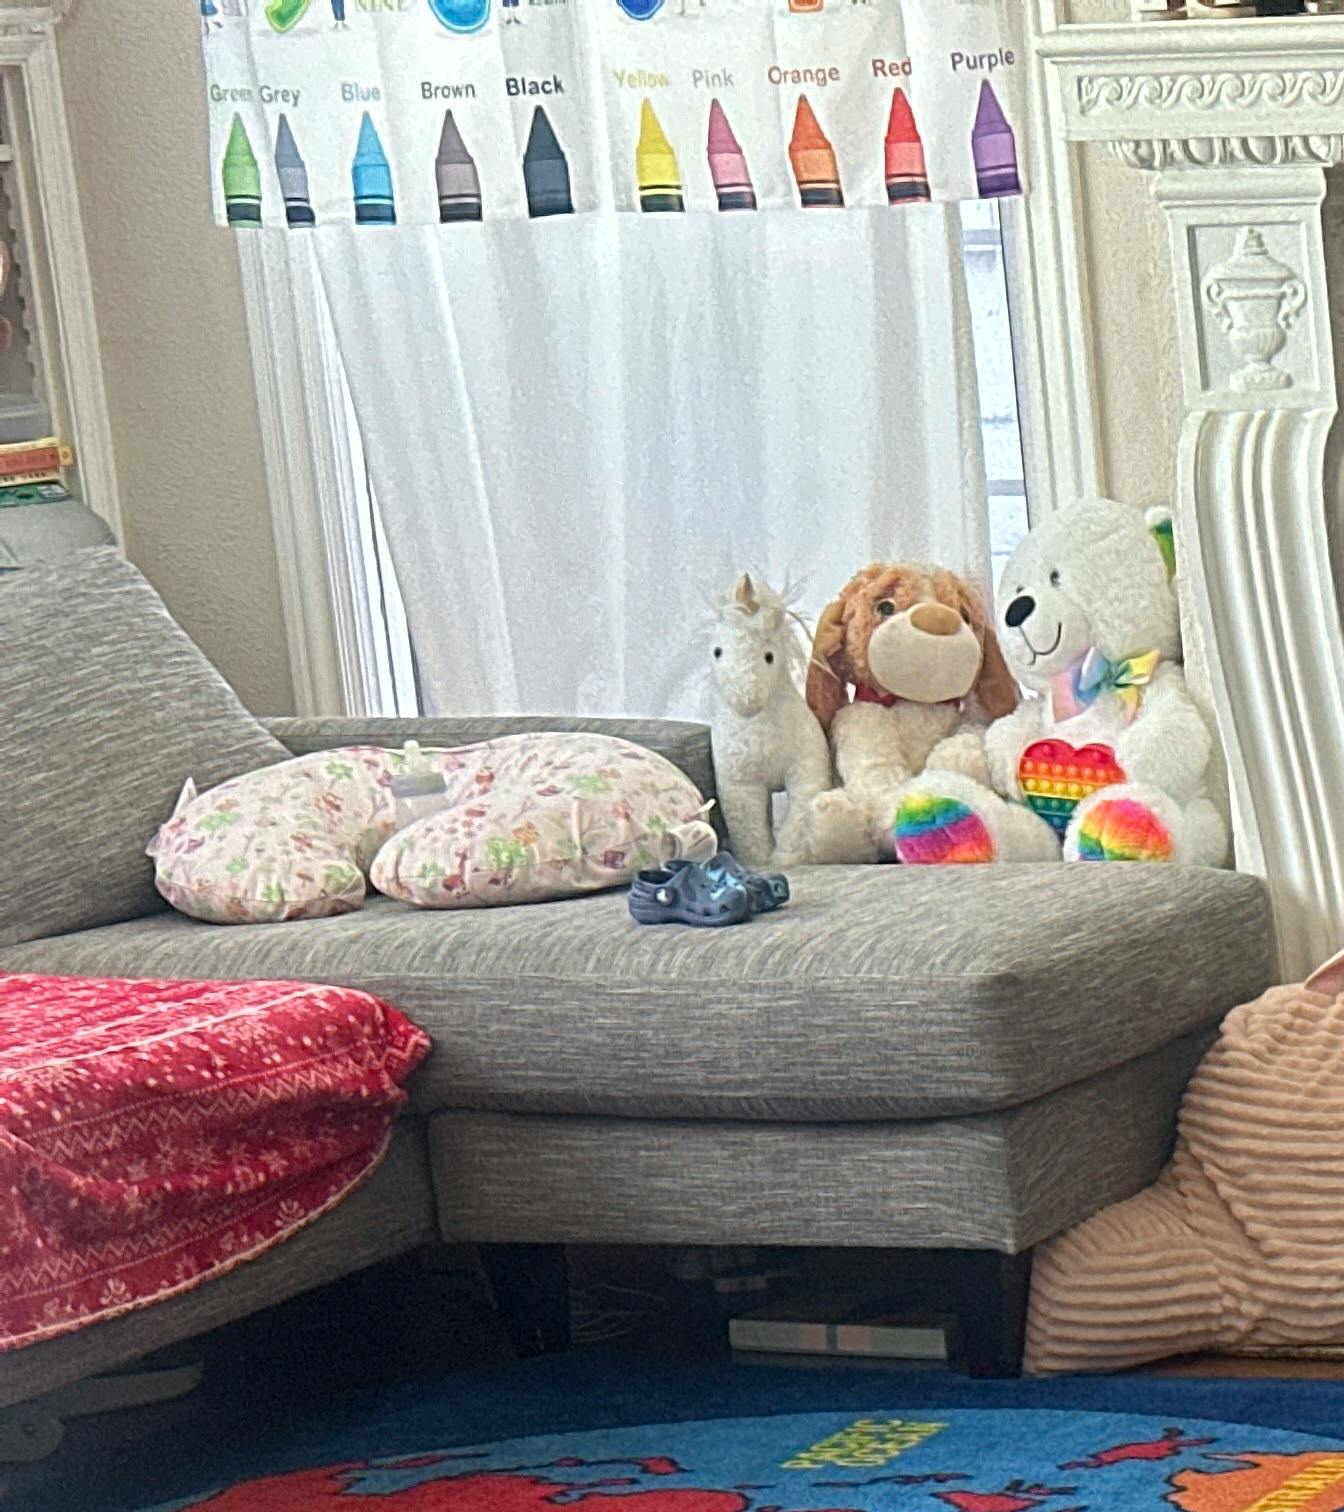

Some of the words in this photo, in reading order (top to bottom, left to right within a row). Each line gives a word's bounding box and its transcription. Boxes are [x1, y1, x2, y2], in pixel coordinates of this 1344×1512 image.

[872, 56, 913, 78] Red
[951, 48, 1015, 74] Purple
[506, 75, 564, 97] Black
[614, 69, 671, 89] Yellow
[692, 68, 734, 88] Pink
[768, 64, 840, 87] Orange
[259, 85, 300, 107] Grey
[342, 82, 381, 102] Blue
[421, 81, 476, 99] Brown
